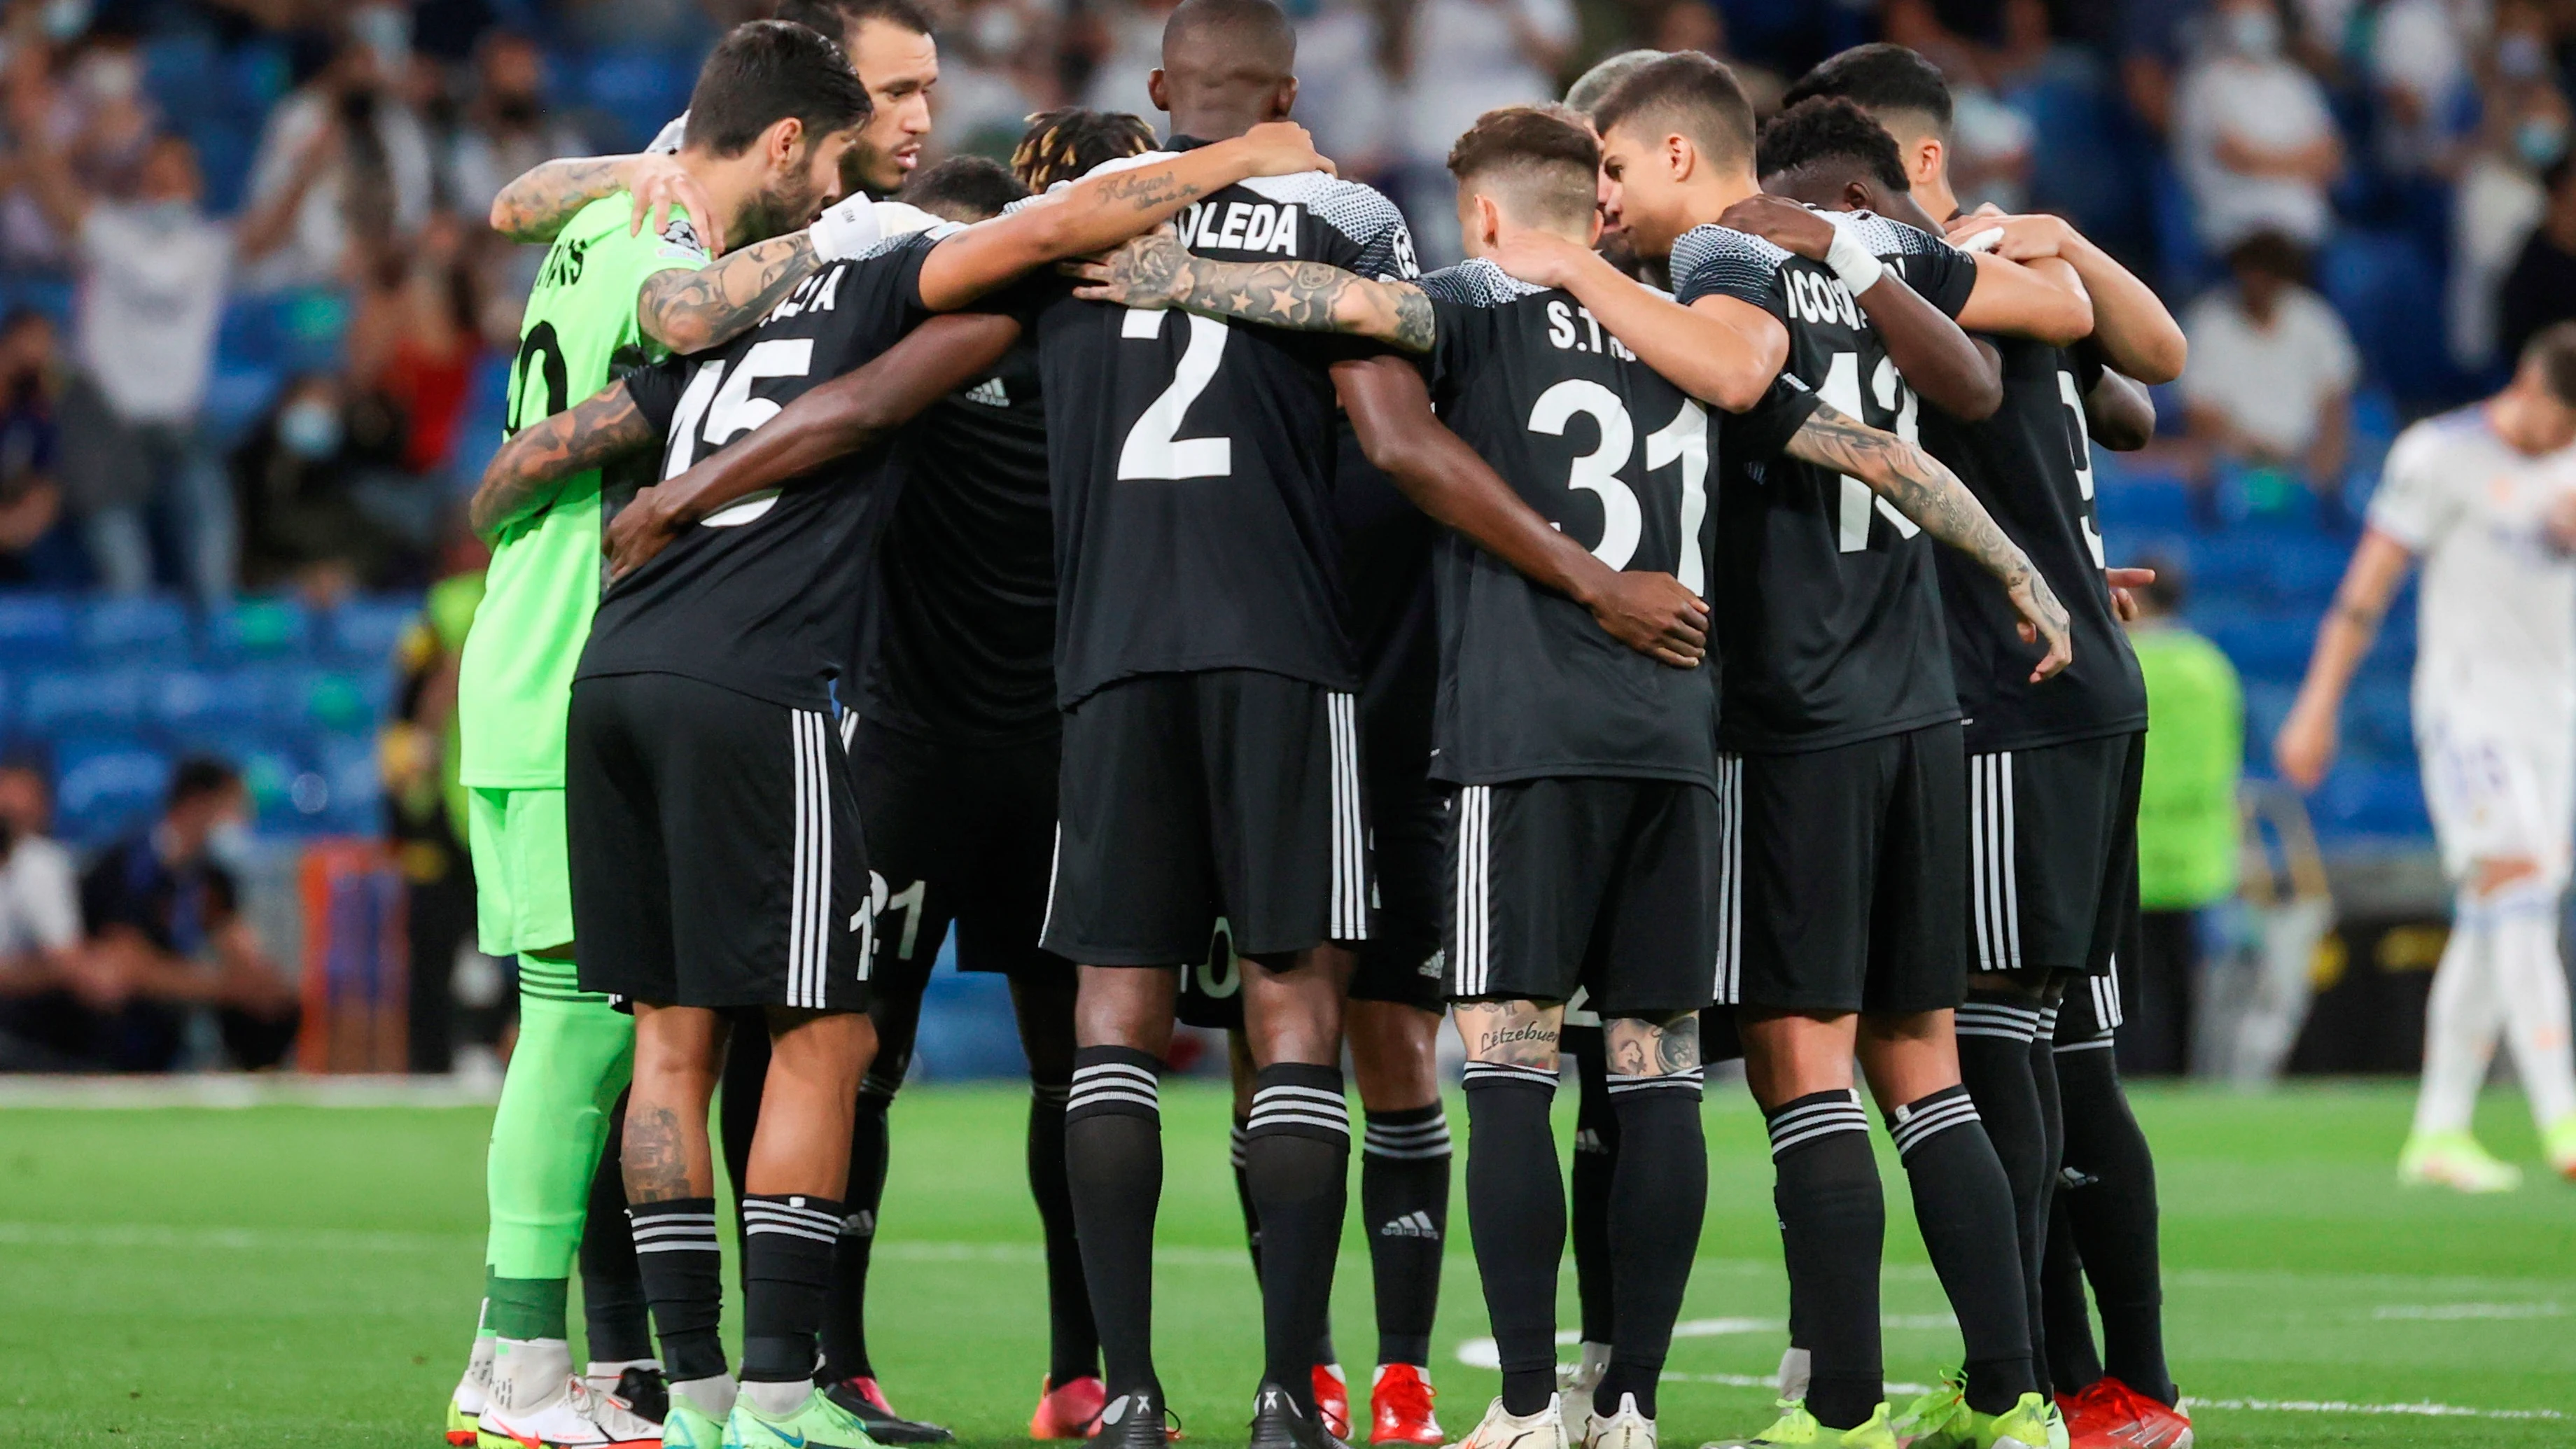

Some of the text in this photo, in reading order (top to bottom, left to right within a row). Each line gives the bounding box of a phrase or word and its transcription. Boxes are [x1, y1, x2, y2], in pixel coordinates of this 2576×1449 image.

[665, 339, 814, 527] 15
[1117, 308, 1231, 480] 2
[1528, 379, 1708, 597] 31
